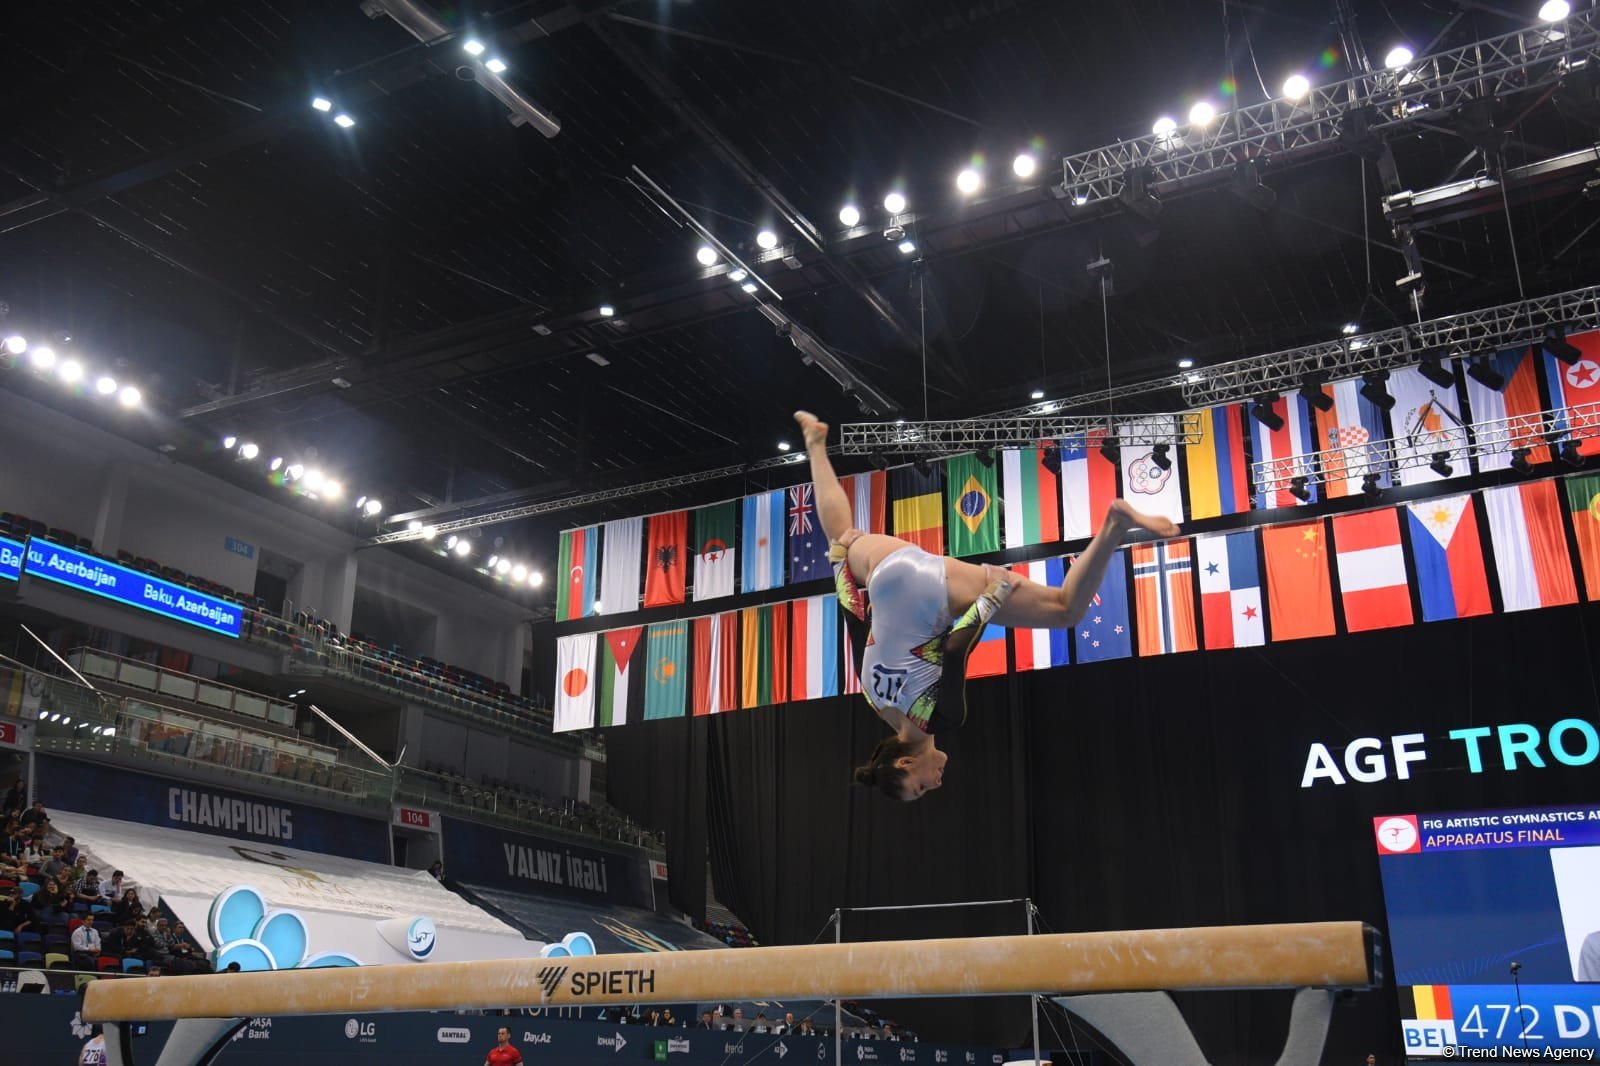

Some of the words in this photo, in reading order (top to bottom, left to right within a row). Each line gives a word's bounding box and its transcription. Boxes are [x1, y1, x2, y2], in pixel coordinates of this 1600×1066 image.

[47, 553, 117, 587] Azerbaijan
[143, 583, 175, 607] Baku,
[175, 594, 234, 625] Azerbaijan
[1300, 733, 1427, 788] AGF
[1449, 718, 1600, 774] TRO
[168, 787, 293, 840] CHAMPIONS
[407, 810, 423, 825] 104
[1423, 819, 1443, 830] FIG
[1446, 815, 1499, 829] ARTISTIC
[1502, 810, 1585, 825] GYMNASTICS
[1426, 830, 1514, 847] APPARATUS
[1517, 828, 1565, 842] FINAL
[503, 842, 562, 885] YALNIZ
[570, 969, 655, 996] SPIETH
[360, 1022, 375, 1036] LG
[1460, 1004, 1544, 1040] 472
[248, 1029, 270, 1039] Bank
[523, 1031, 551, 1044] Day.Az
[1406, 1028, 1456, 1048] BEL
